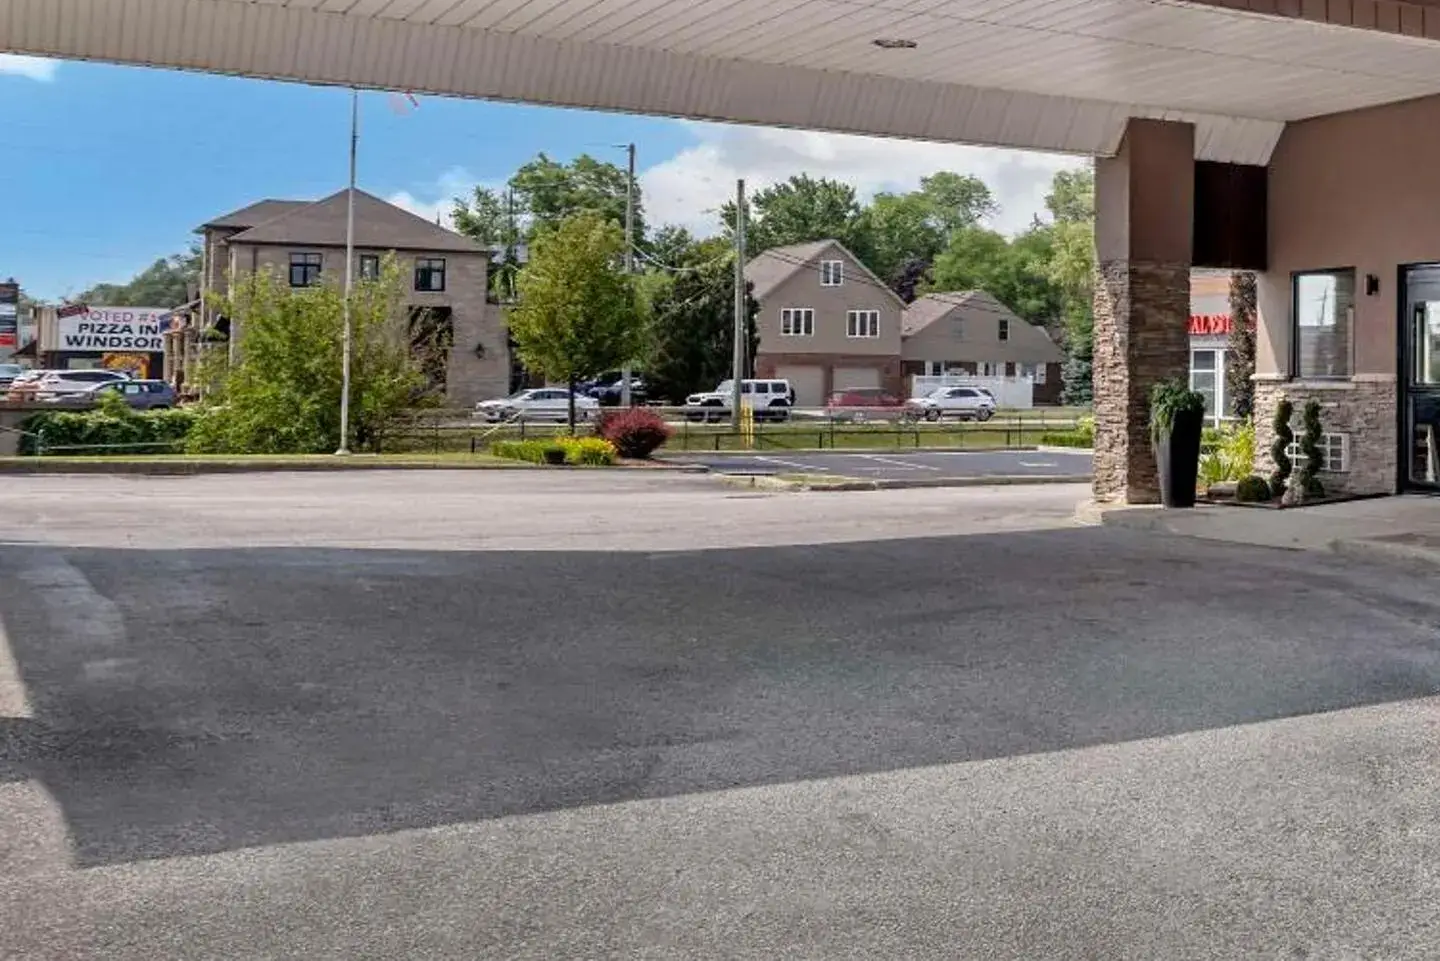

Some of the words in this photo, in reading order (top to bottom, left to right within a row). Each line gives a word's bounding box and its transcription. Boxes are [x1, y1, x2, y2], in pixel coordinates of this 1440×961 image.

[80, 311, 134, 323] VOTED
[78, 323, 134, 335] PIZZA
[139, 323, 158, 335] IN
[65, 335, 163, 349] WINDSOR
